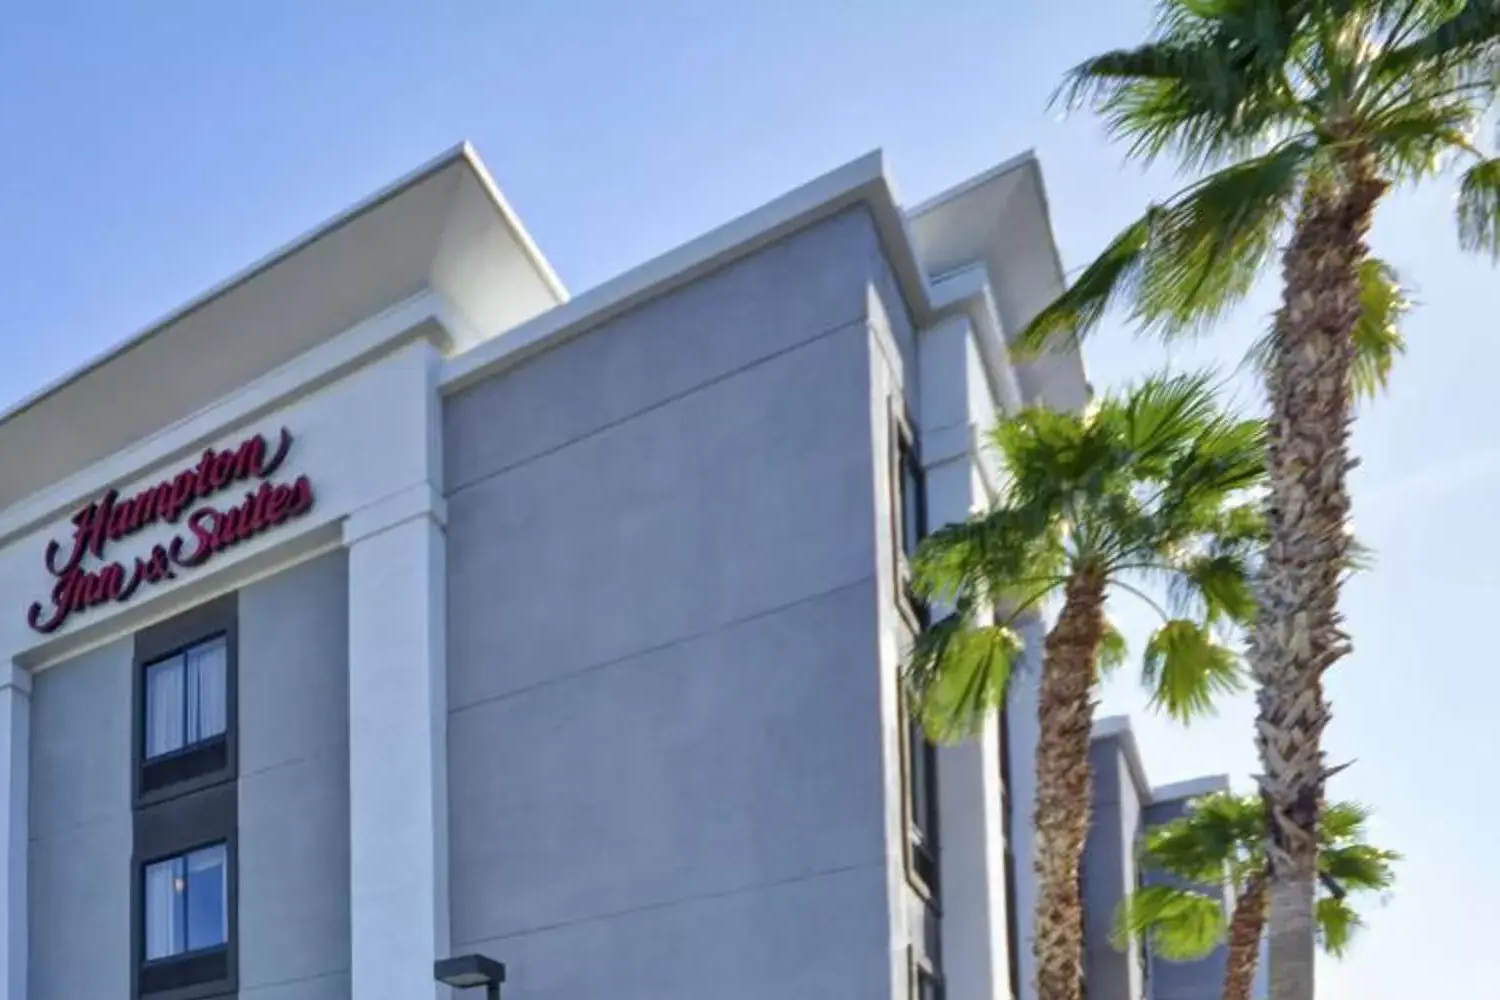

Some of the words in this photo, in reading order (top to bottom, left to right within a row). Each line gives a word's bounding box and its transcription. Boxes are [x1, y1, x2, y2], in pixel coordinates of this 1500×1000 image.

[27, 557, 141, 633] Inn
[141, 544, 177, 582] &
[169, 474, 313, 567] Suites
[45, 425, 293, 576] Hampton
